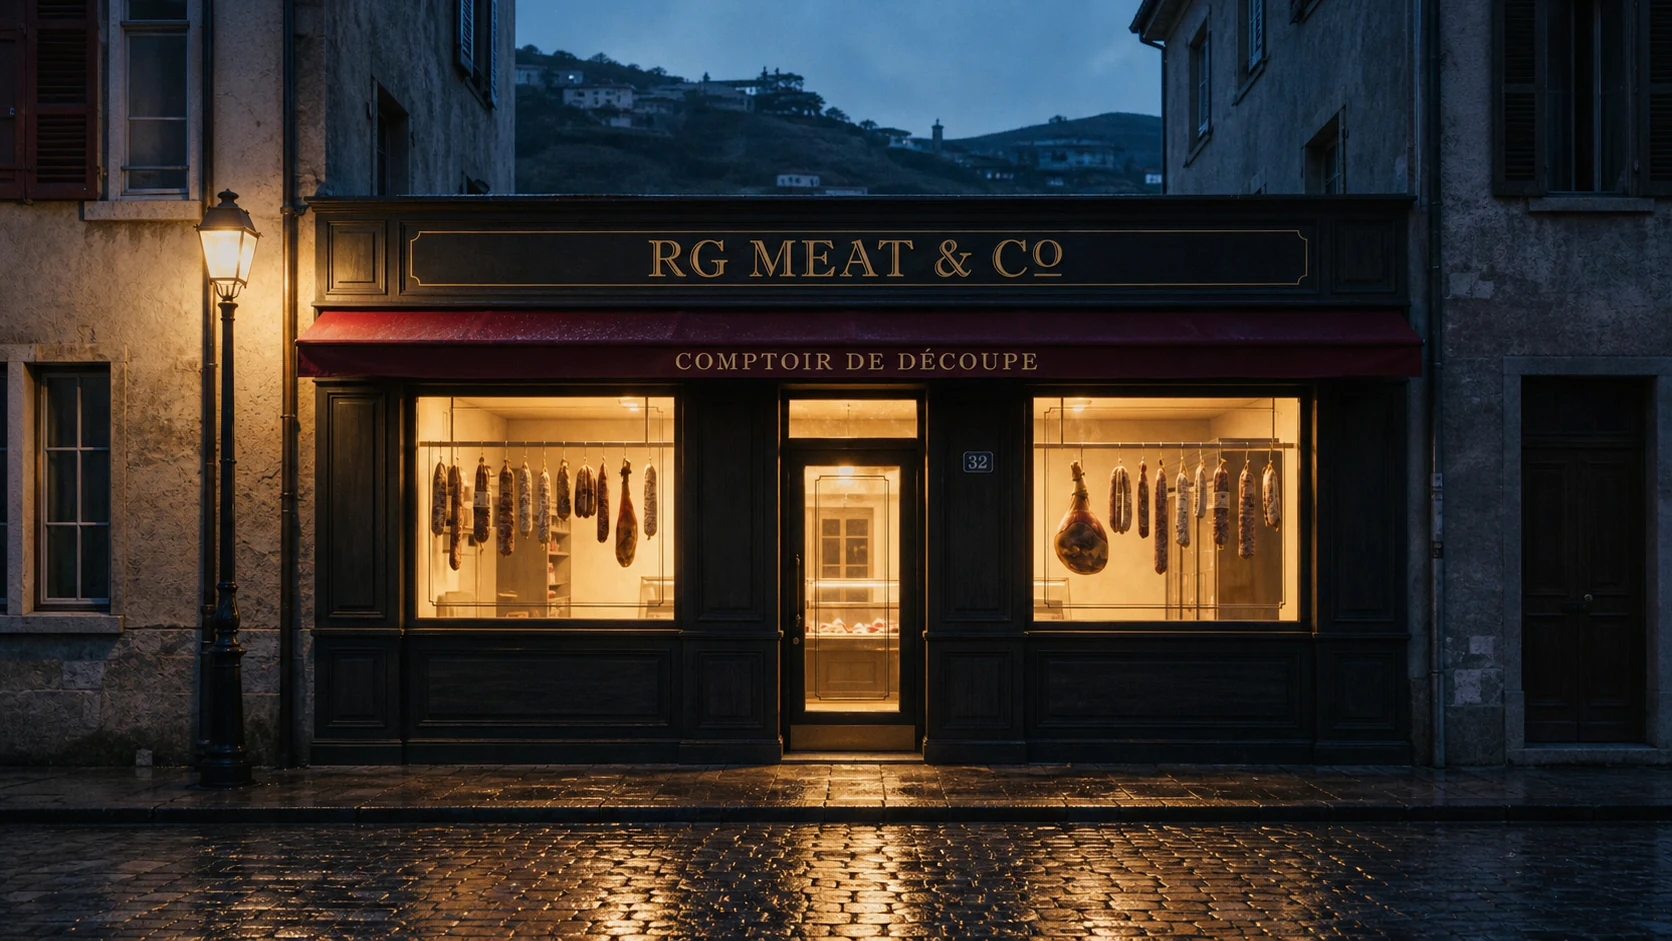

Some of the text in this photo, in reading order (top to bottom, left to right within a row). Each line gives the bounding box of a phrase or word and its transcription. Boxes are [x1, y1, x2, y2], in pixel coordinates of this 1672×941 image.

[648, 239, 728, 277] RG
[750, 239, 914, 277] MEAT
[934, 239, 972, 278] &
[675, 348, 1039, 370] COMPTOIR DE DÉCOUPE
[968, 455, 988, 469] 32
